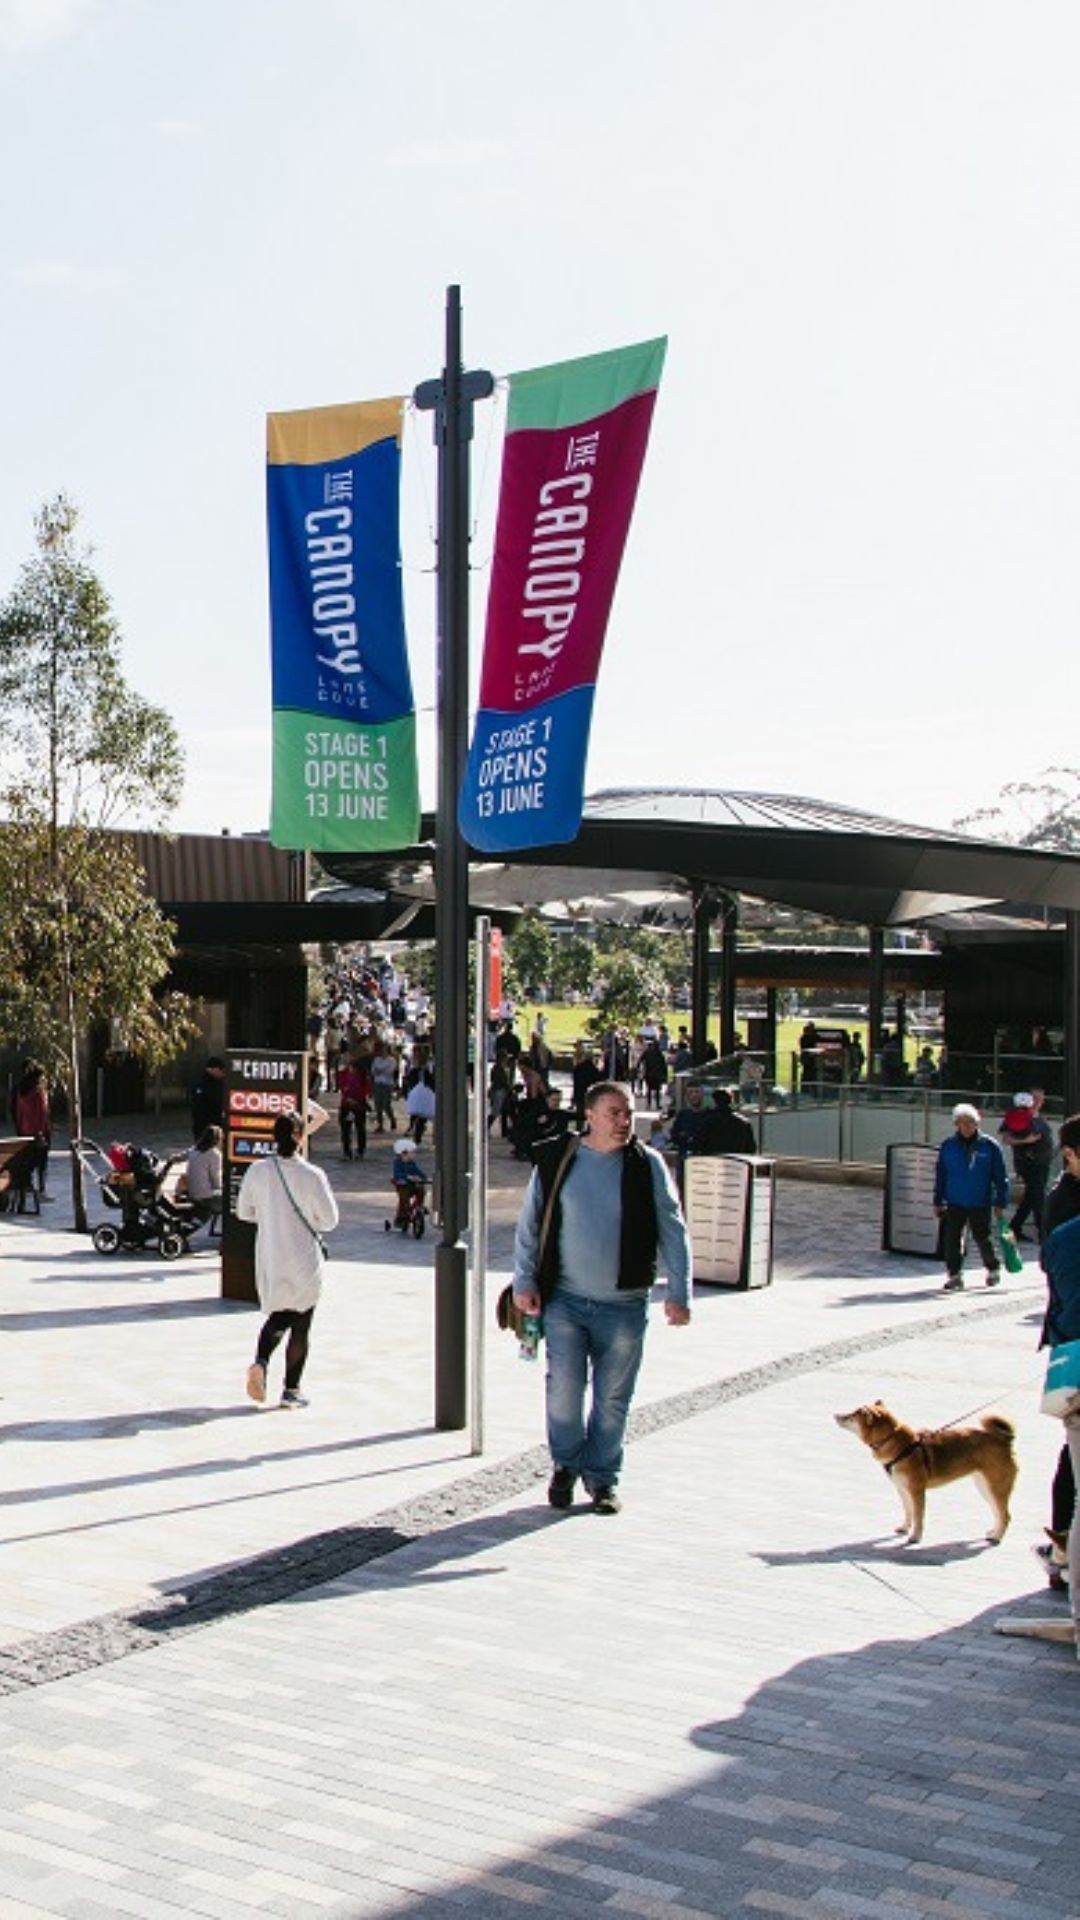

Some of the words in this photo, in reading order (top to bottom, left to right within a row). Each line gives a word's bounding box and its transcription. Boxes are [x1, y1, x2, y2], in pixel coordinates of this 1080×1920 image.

[572, 431, 600, 469] THE
[331, 469, 354, 502] THE
[517, 472, 594, 659] CANOPY
[304, 505, 363, 675] CANOPY
[304, 732, 370, 757] STAGE
[376, 735, 387, 758] 1
[485, 718, 537, 755] STAGE
[542, 715, 553, 742] 1
[304, 759, 389, 792] OPENS
[479, 746, 547, 788] OPENS
[305, 792, 329, 817] 13
[336, 793, 389, 820] JUNE
[476, 790, 495, 818] 13
[498, 782, 544, 815] JUNE
[243, 1060, 298, 1081] CANOPY
[230, 1092, 296, 1115] coles
